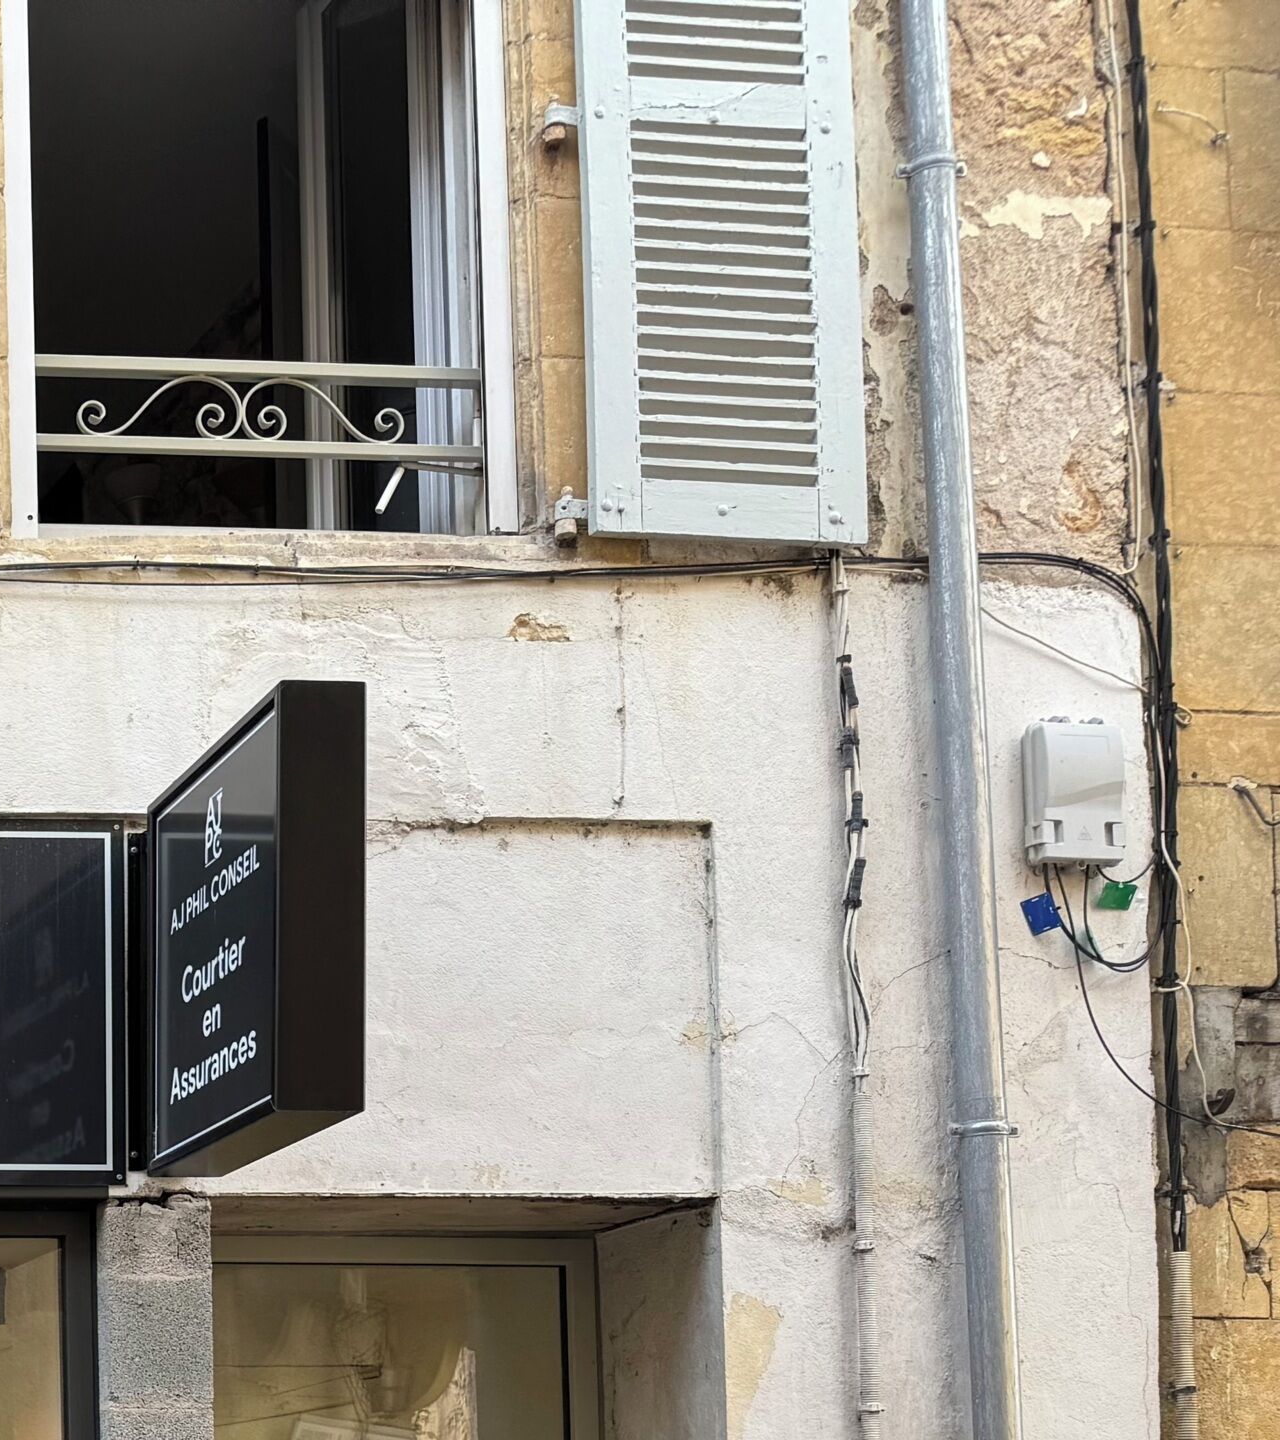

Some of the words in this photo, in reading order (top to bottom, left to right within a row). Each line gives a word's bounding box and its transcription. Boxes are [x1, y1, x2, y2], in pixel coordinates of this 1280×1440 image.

[169, 903, 186, 936] AJ
[185, 890, 209, 924] PHIL
[210, 844, 260, 903] CONSEIL
[181, 935, 246, 1003] Courtier
[202, 1003, 222, 1038] en
[169, 1029, 257, 1106] Assurances
